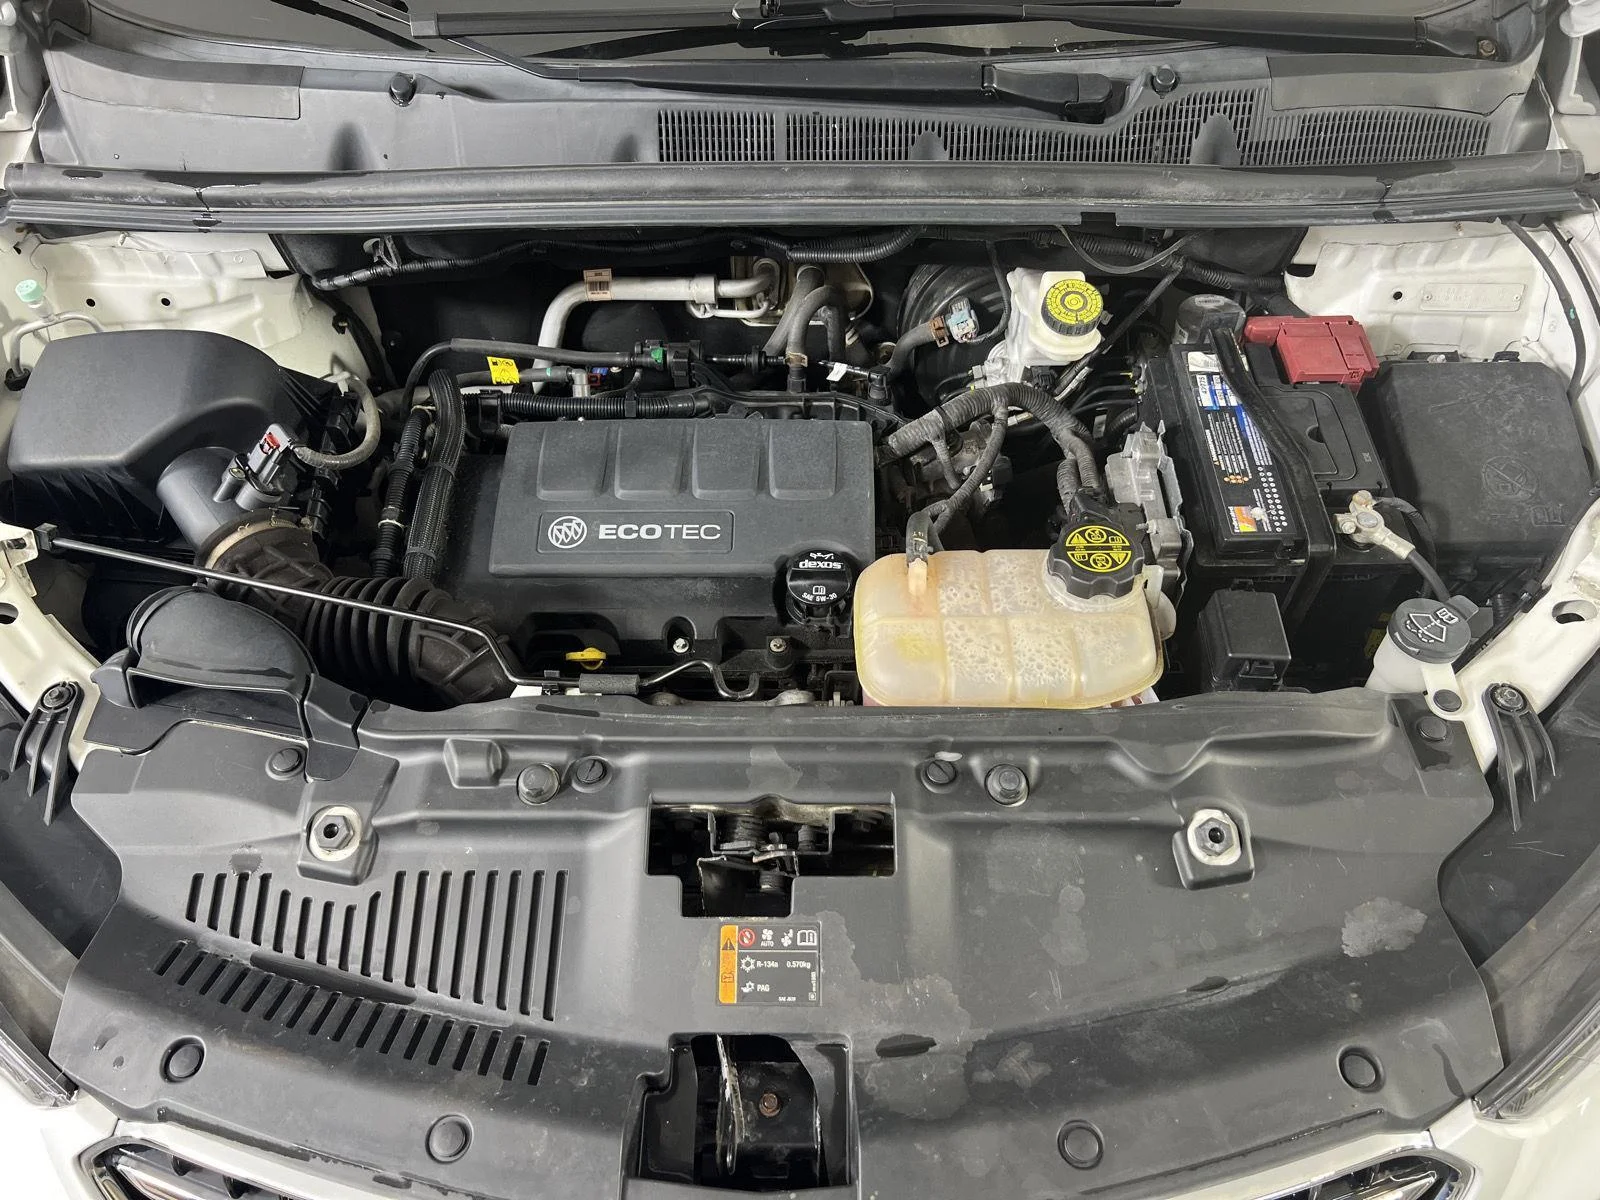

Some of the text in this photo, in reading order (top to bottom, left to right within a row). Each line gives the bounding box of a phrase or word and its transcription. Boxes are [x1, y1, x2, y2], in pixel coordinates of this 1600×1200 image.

[598, 524, 721, 540] ECOTEC
[798, 559, 843, 569] dexos
[802, 592, 838, 602] SAE 5W-30
[786, 961, 811, 969] 0.570kg
[757, 984, 770, 992] PAG
